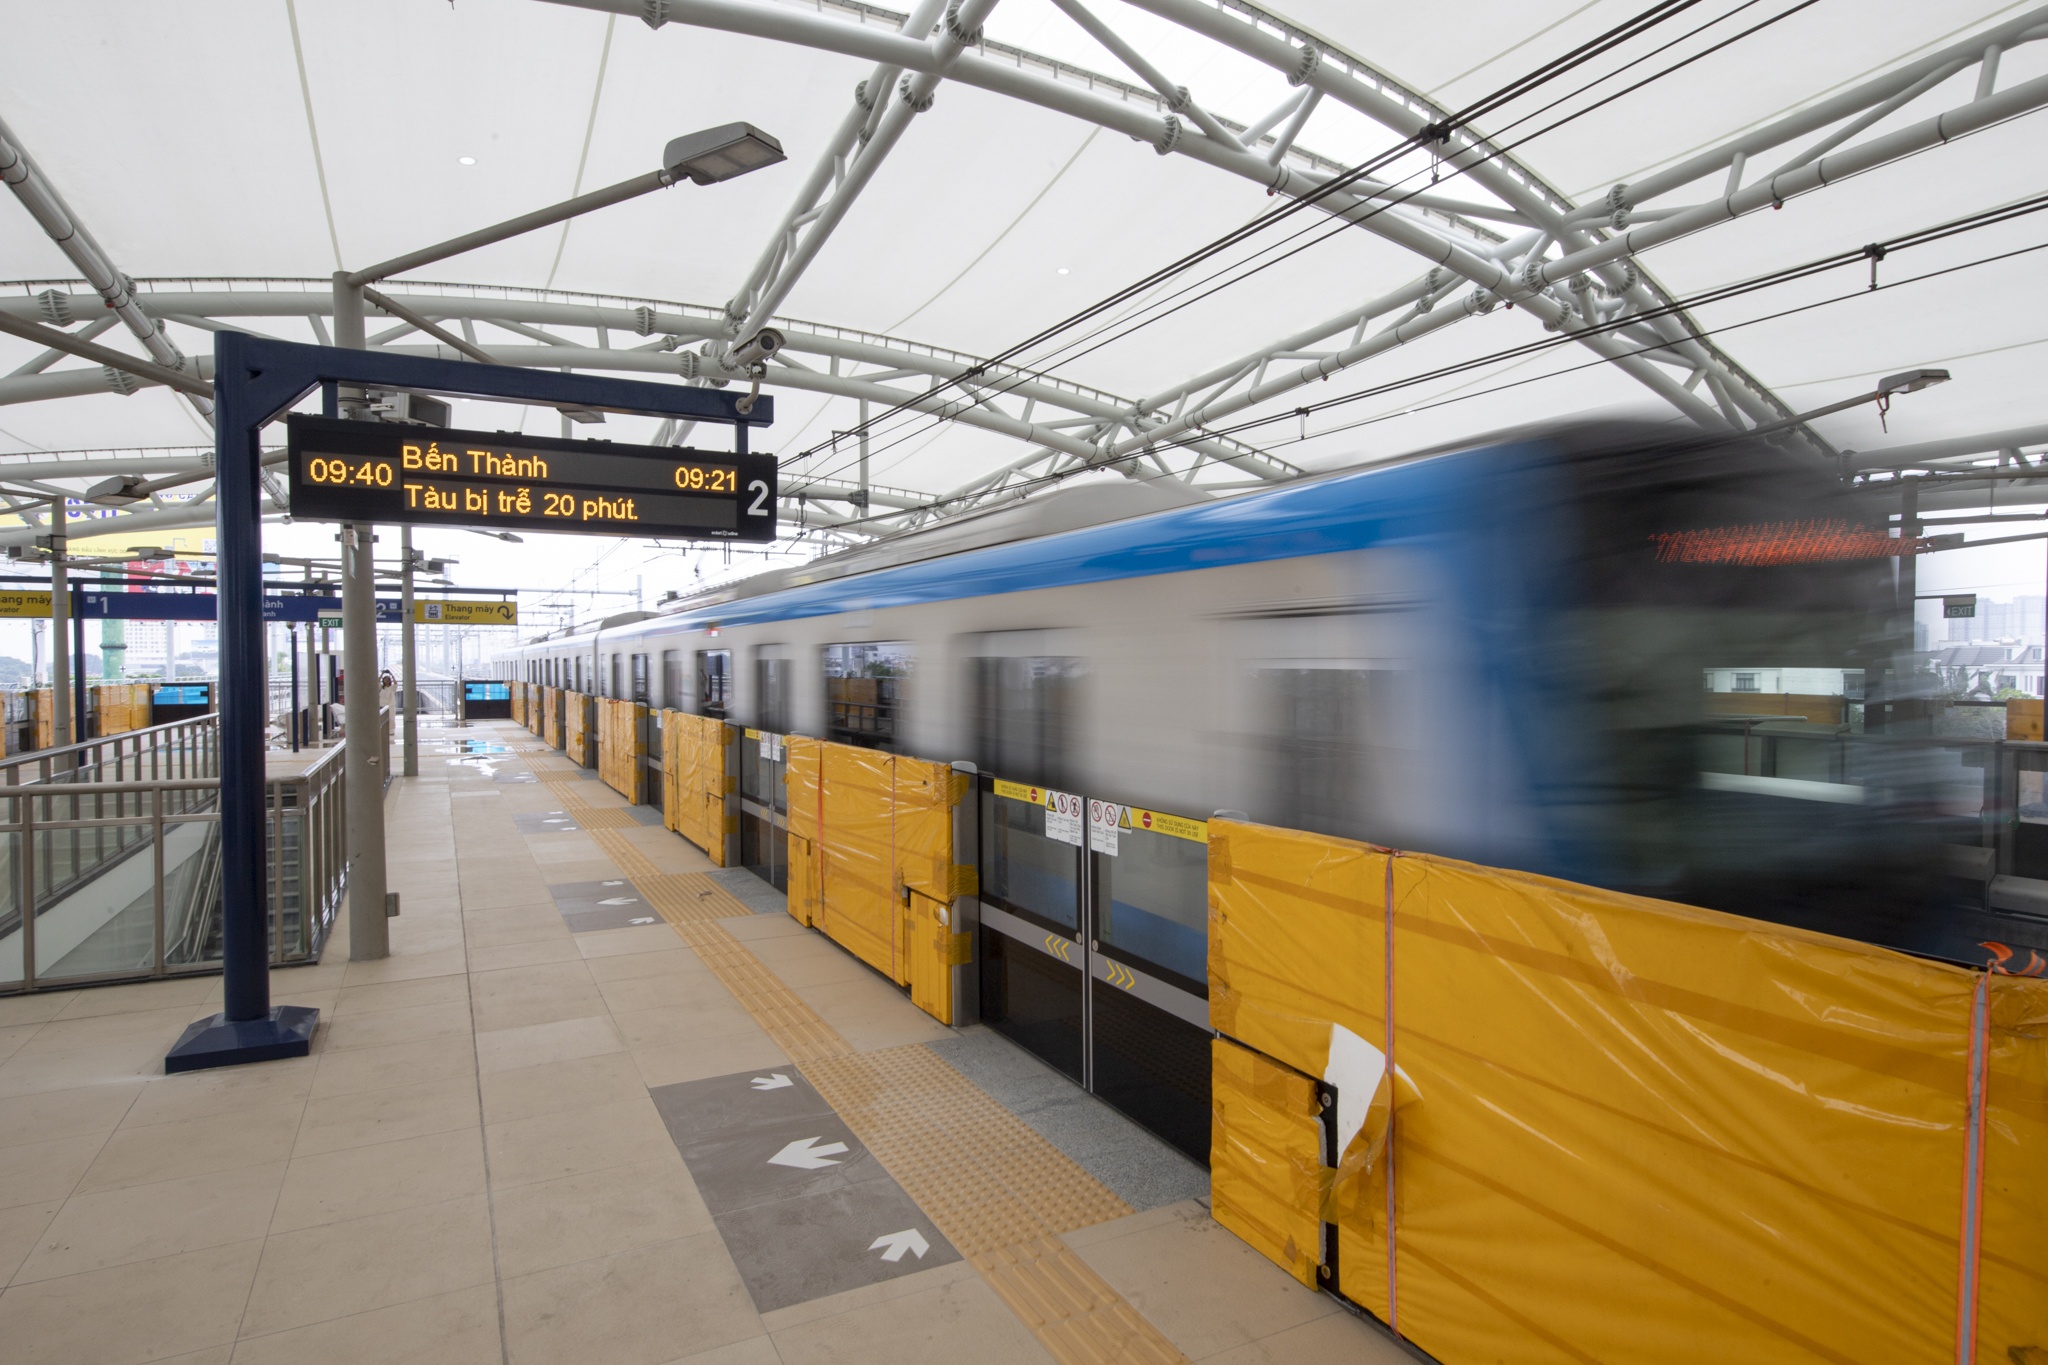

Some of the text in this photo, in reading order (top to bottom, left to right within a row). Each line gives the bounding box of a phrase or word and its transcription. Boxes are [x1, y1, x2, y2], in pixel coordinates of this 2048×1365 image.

[402, 442, 549, 479] Bến Thành
[309, 457, 393, 487] 09:40
[674, 466, 737, 492] 09:21
[403, 484, 639, 522] Tàu bị trễ 20 phút.
[746, 479, 770, 517] 2
[0, 594, 52, 606] ang máy
[100, 596, 109, 614] 1
[262, 599, 284, 609] ành
[375, 602, 387, 618] 2
[445, 604, 495, 614] Thang máy
[1952, 606, 1973, 616] EXIT
[322, 618, 340, 627] EXIT
